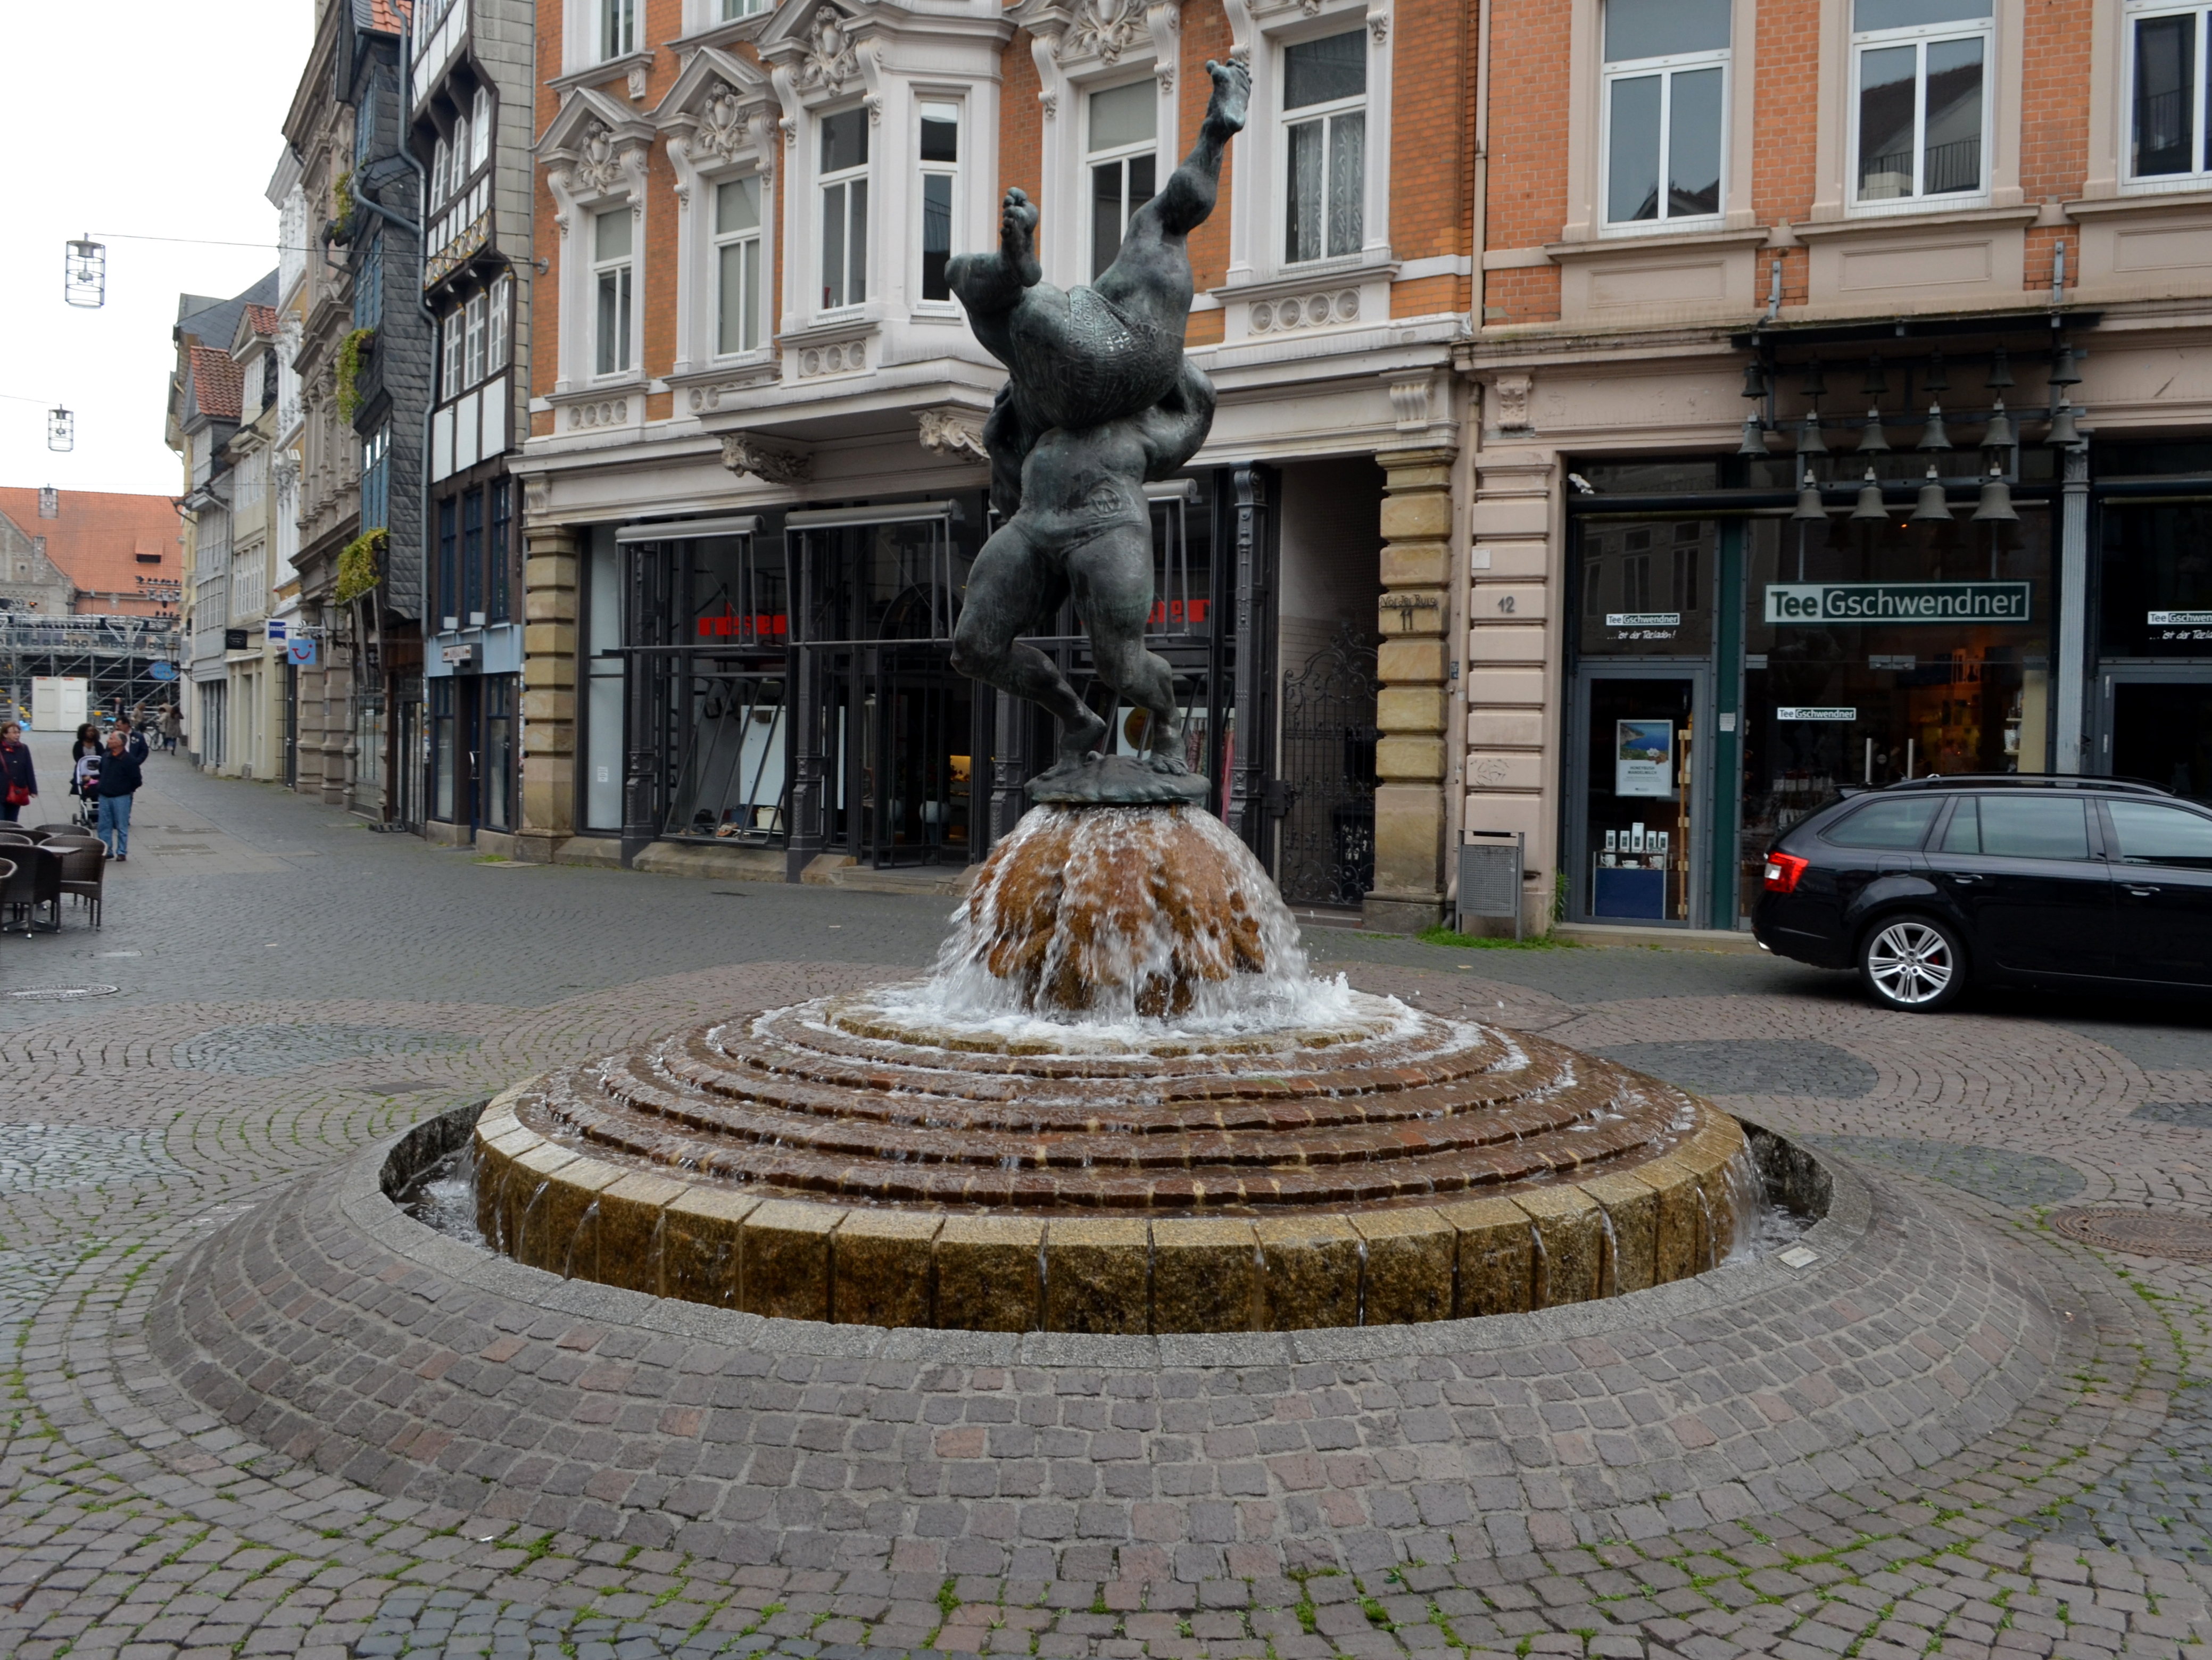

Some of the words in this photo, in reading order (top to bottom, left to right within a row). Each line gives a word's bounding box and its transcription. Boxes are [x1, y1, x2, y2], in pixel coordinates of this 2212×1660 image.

[1497, 596, 1515, 613] 12
[1770, 591, 1818, 617] Tee
[1826, 588, 2022, 616] Gschwendner
[1399, 608, 1413, 631] 11
[1623, 615, 1677, 623] Gschwendner
[2150, 613, 2166, 622] Tee
[1795, 709, 1853, 718] Gschwendner
